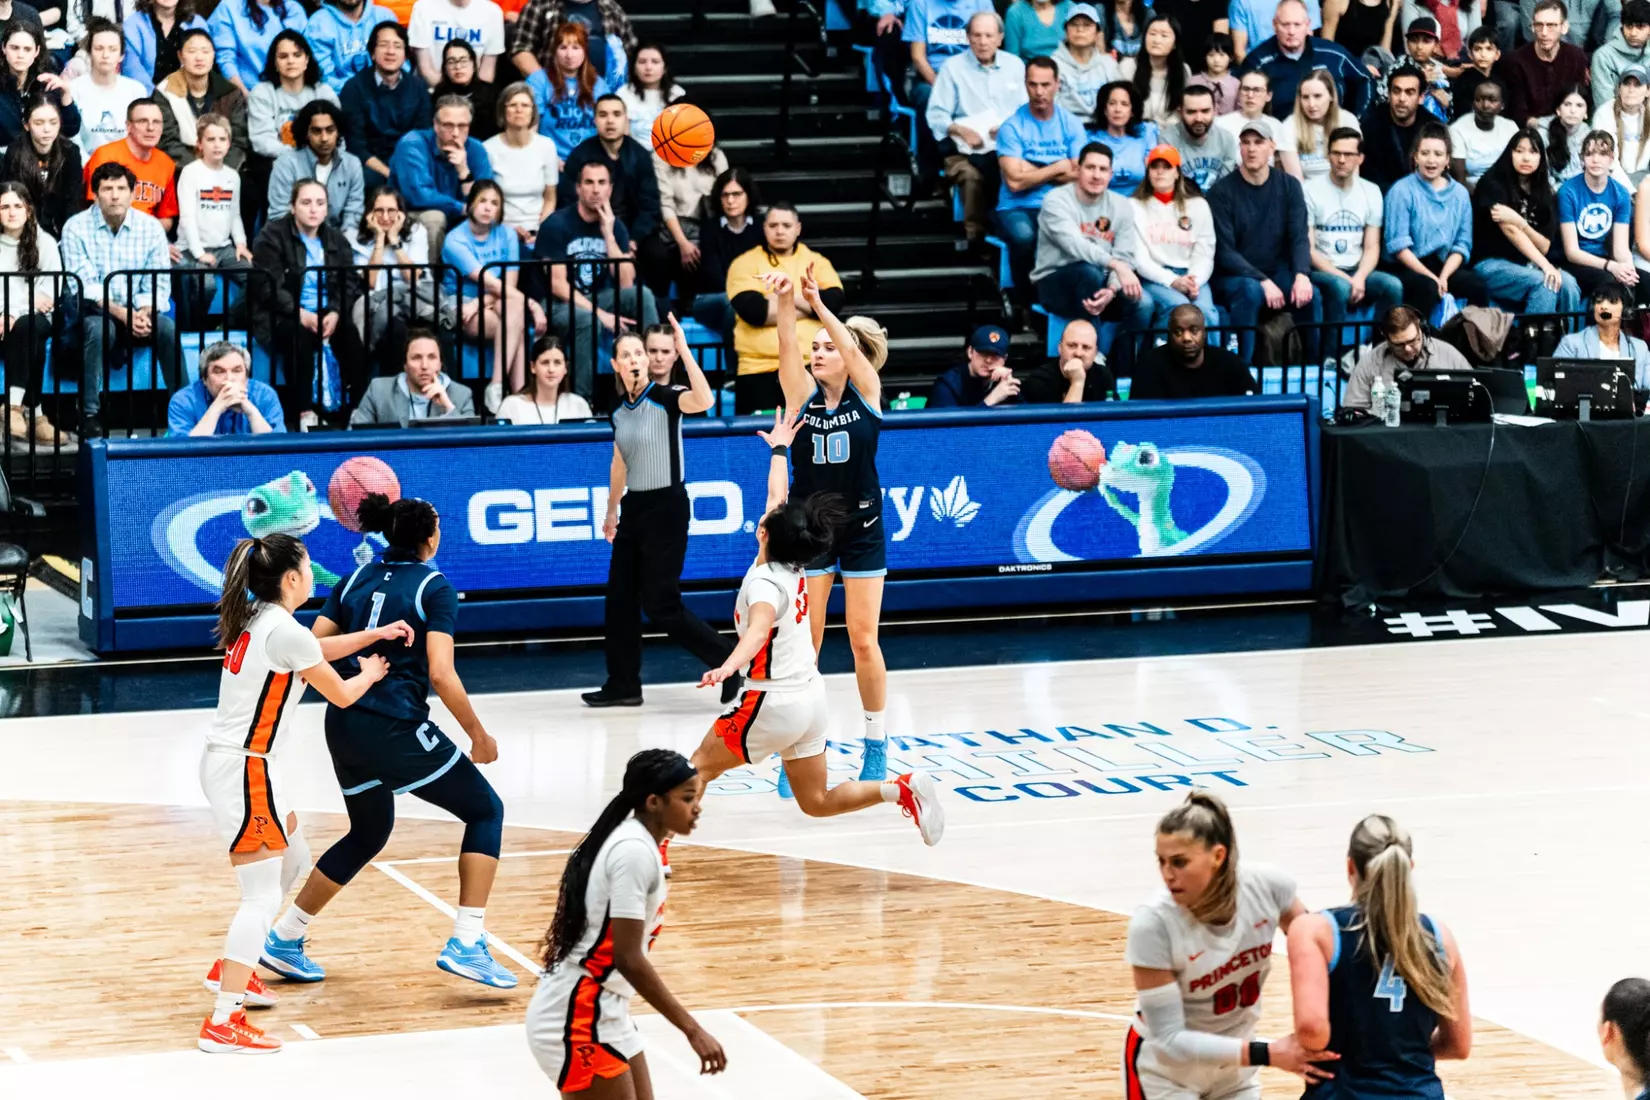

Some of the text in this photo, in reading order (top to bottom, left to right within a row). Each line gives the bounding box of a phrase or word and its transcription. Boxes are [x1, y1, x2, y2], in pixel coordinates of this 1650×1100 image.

[434, 26, 481, 42] LION
[803, 409, 861, 430] COLUMBIA
[811, 430, 851, 464] 10
[467, 481, 745, 545] GEIO
[383, 571, 393, 581] C
[998, 563, 1053, 573] DAKTRONICS
[364, 591, 387, 632] 1
[415, 722, 440, 752] C
[1183, 717, 1279, 733] D.
[702, 729, 1438, 797] SHILLER
[953, 770, 1249, 802] COURT
[1373, 953, 1407, 1012] 4
